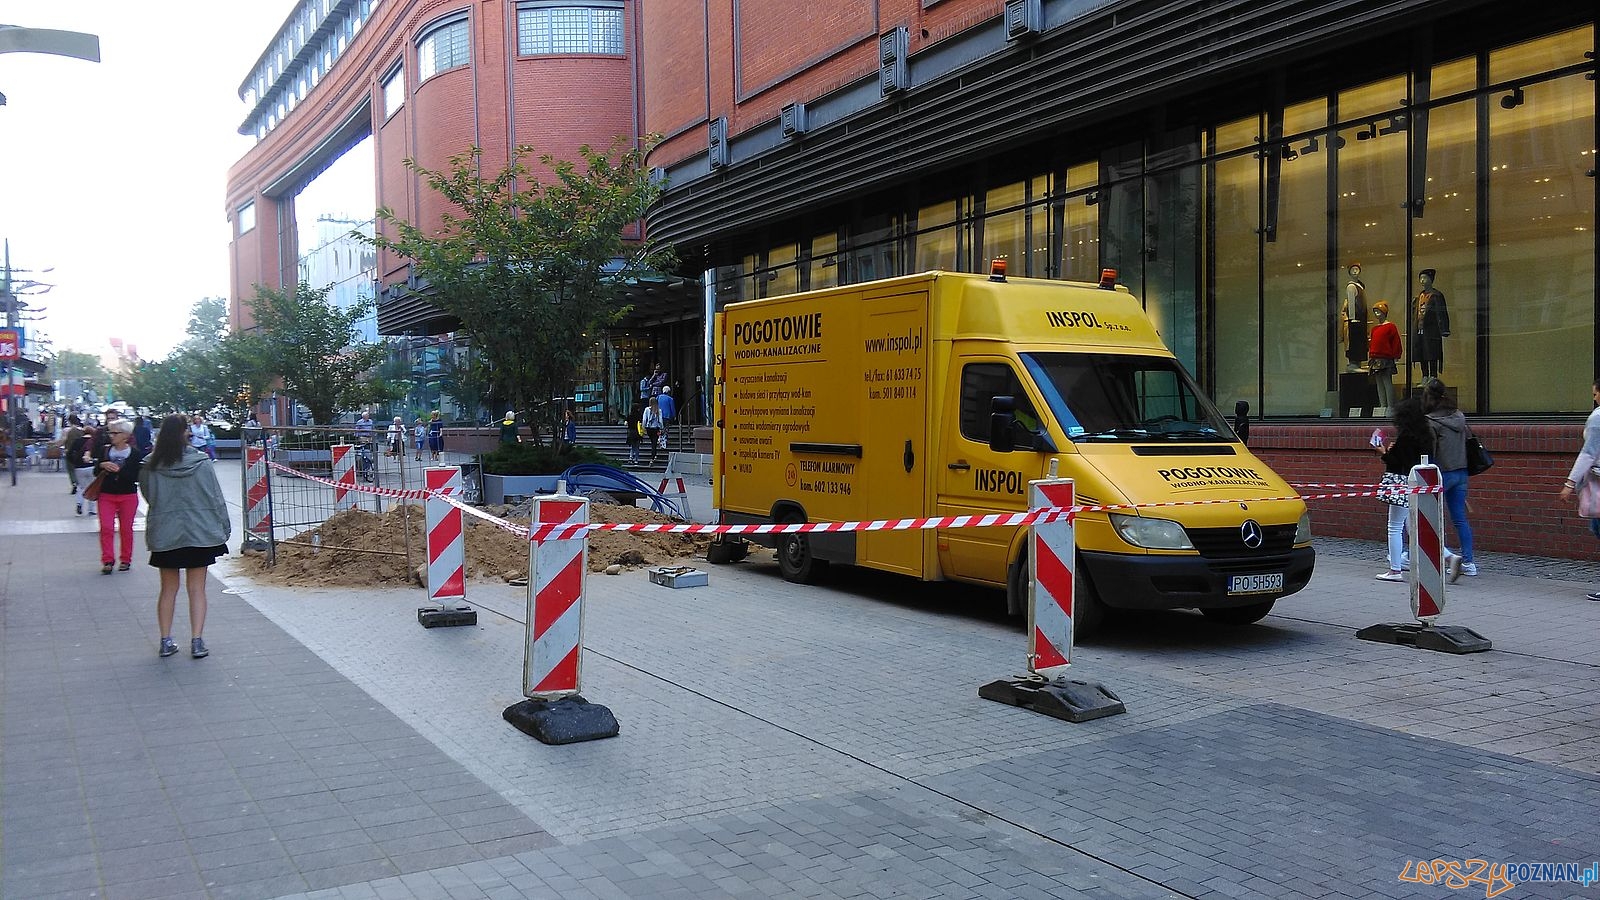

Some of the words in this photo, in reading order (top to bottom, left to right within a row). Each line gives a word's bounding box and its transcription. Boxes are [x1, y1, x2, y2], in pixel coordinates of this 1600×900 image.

[1045, 311, 1102, 328] INSPOL
[734, 312, 822, 346] POGOTOWIE
[864, 326, 923, 356] www.inspol.pl
[734, 343, 822, 360] WODNO-KANALIZACYJNE
[764, 371, 788, 384] kanalizacji
[886, 369, 893, 381] 61
[894, 368, 905, 381] 633
[906, 368, 913, 380] 74
[914, 367, 922, 380] 75
[739, 389, 756, 399] budowa
[791, 387, 812, 399] wod-kan
[868, 387, 881, 399] kom.
[882, 387, 893, 399] 501
[894, 386, 905, 399] 840
[906, 386, 917, 399] 114
[790, 404, 816, 418] kanalizacji
[755, 420, 781, 433] wodomierzy
[782, 420, 810, 434] ogrodowych
[800, 460, 821, 473] TELEFON
[822, 461, 855, 475] ALARMOWY
[1157, 466, 1264, 482] POGOTOWIE
[800, 478, 813, 492] kom.
[814, 480, 826, 493] 602
[827, 481, 838, 495] 133
[839, 482, 852, 496] 946
[975, 468, 1024, 495] INSPOL
[1170, 480, 1271, 489] WODNO-KANALIZACYJNE
[1233, 577, 1250, 591] PO
[1252, 574, 1282, 590] 5H593
